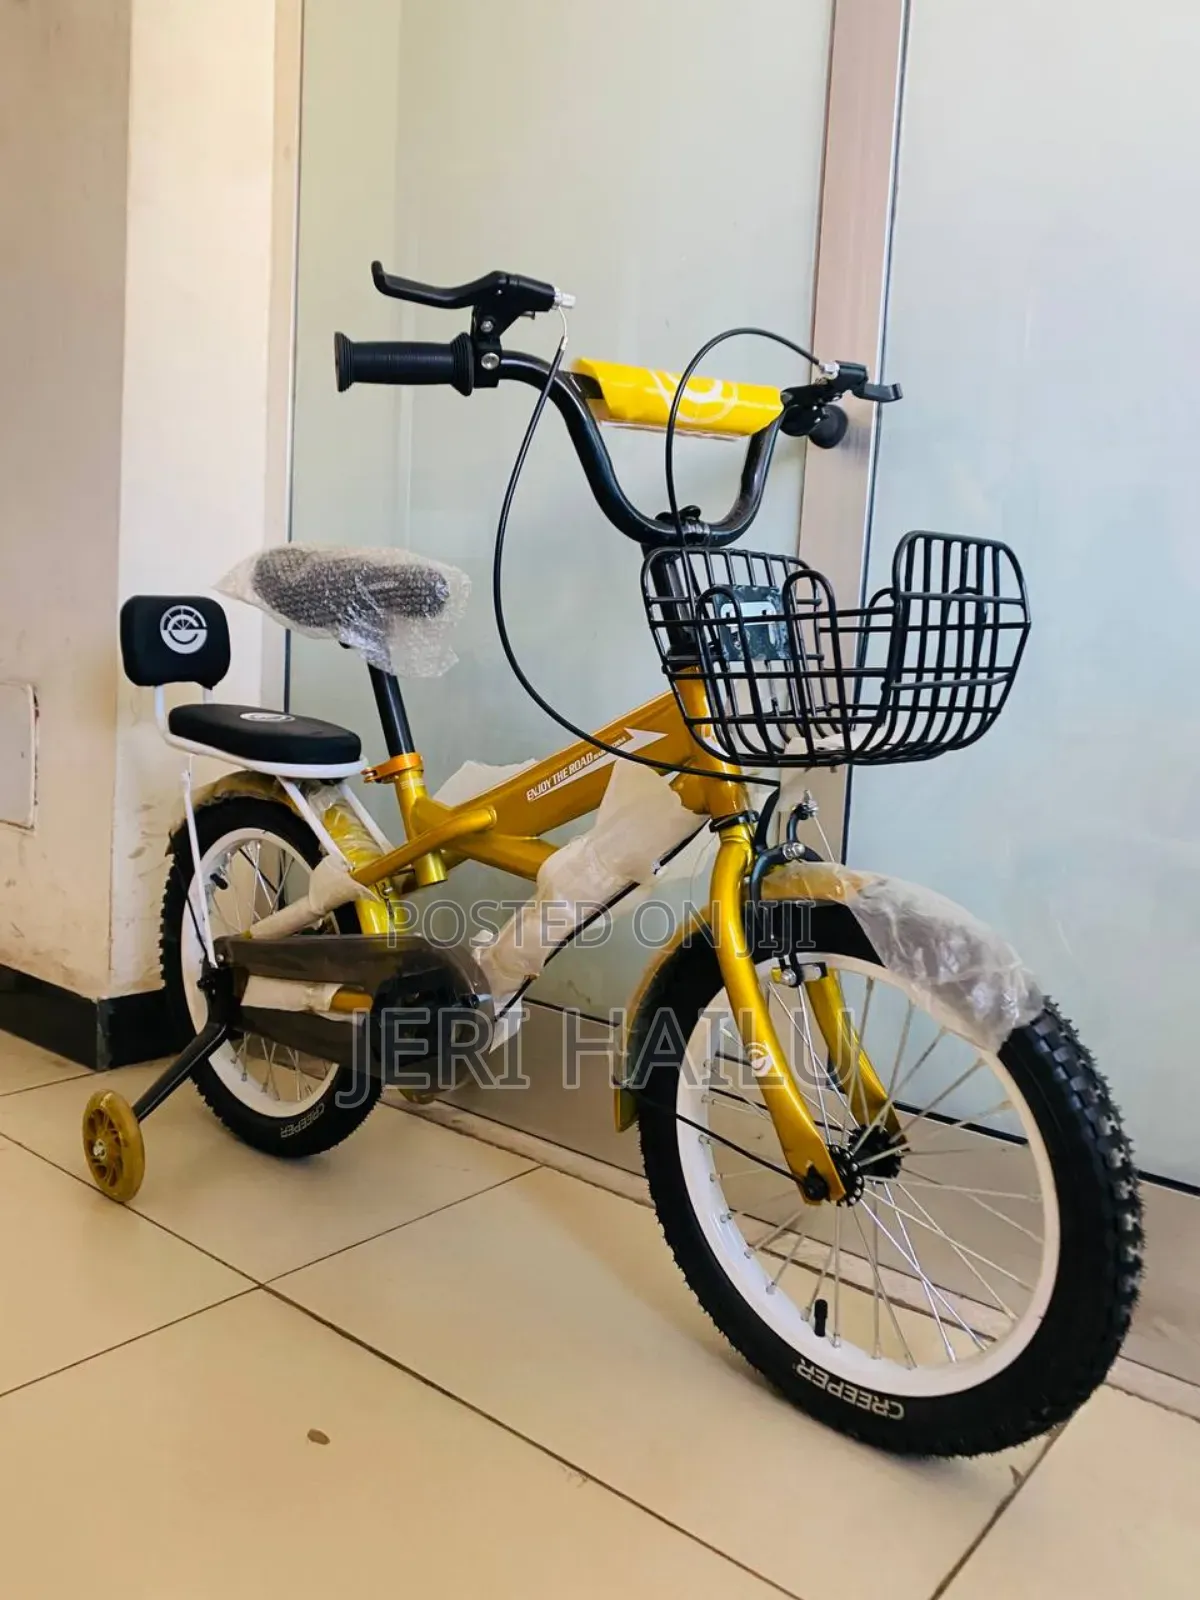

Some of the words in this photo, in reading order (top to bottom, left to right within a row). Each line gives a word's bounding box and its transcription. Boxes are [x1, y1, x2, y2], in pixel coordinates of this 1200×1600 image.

[526, 779, 552, 801] ENJOY
[552, 769, 570, 785] THE
[569, 752, 593, 774] ROAD
[280, 1102, 325, 1138] CREEPER
[795, 1359, 905, 1420] CREEPER
